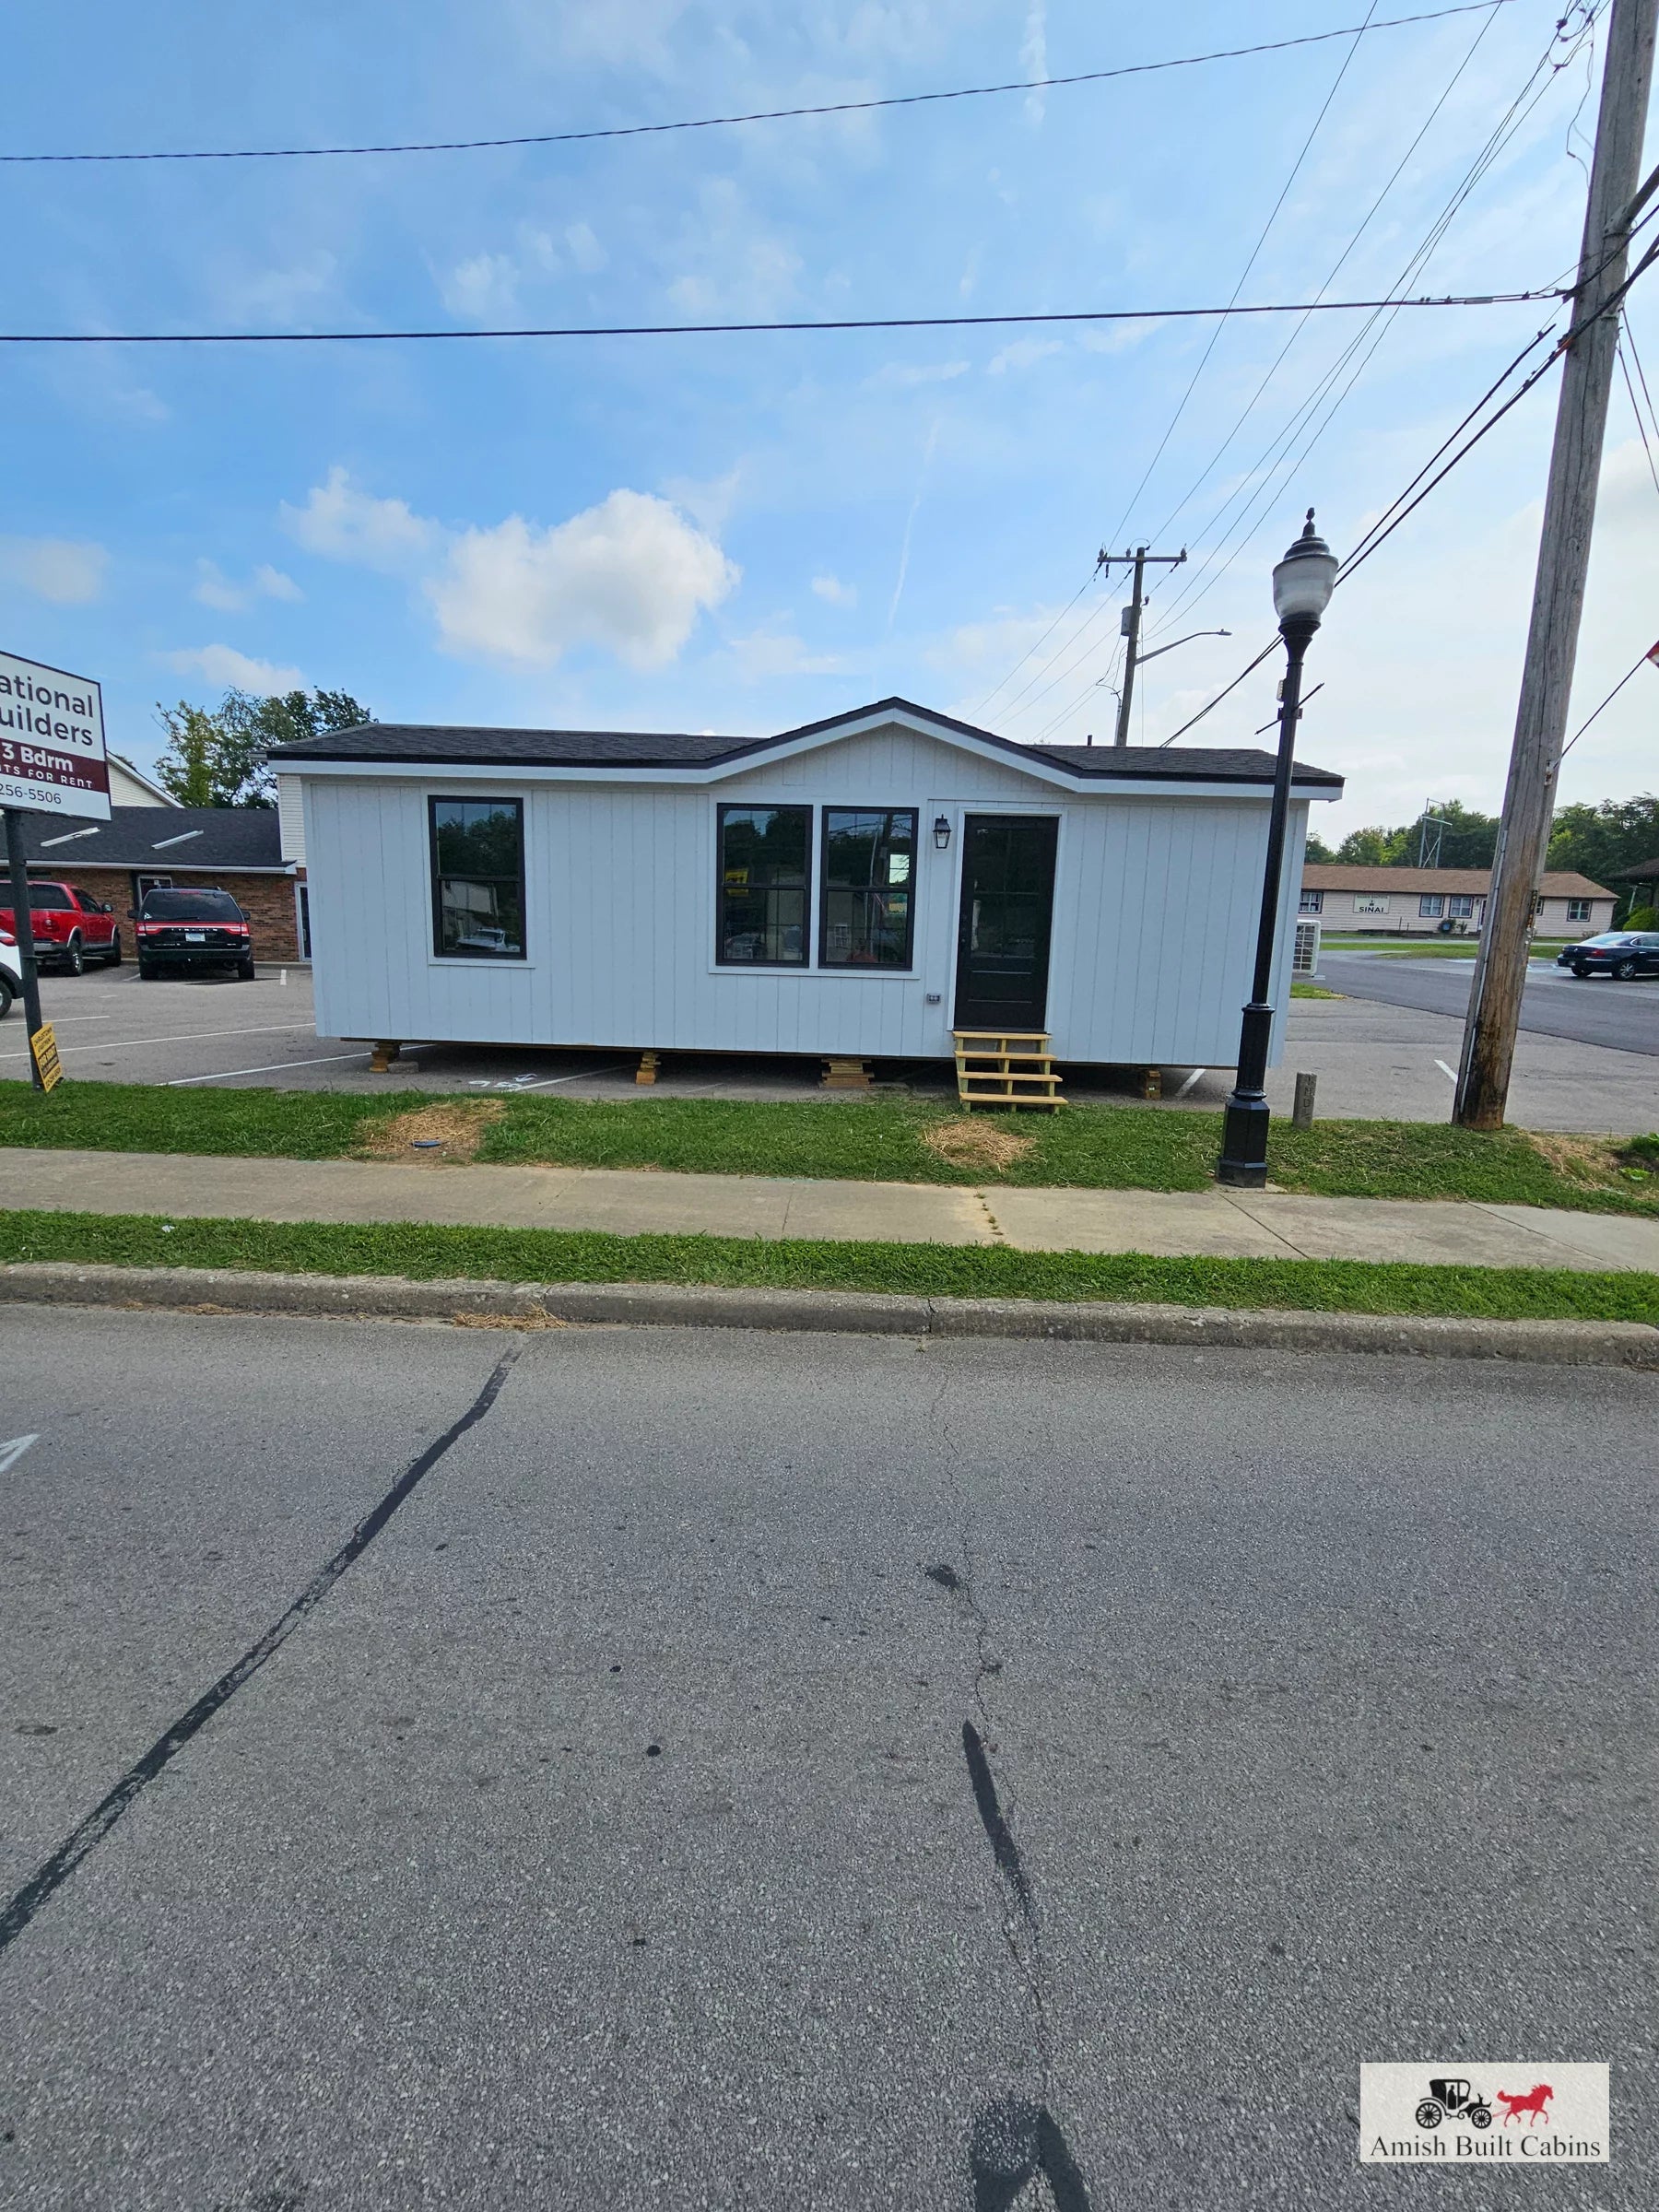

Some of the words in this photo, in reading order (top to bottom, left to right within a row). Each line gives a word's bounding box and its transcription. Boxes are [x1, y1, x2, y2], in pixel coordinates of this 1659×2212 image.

[0, 675, 93, 718] ational
[0, 704, 93, 746] uilders
[2, 742, 15, 759] 3
[20, 746, 73, 772] Bdrm
[0, 764, 20, 775] TS
[28, 769, 53, 782] FOR
[60, 775, 92, 789] RENT
[0, 783, 62, 804] 256-5506
